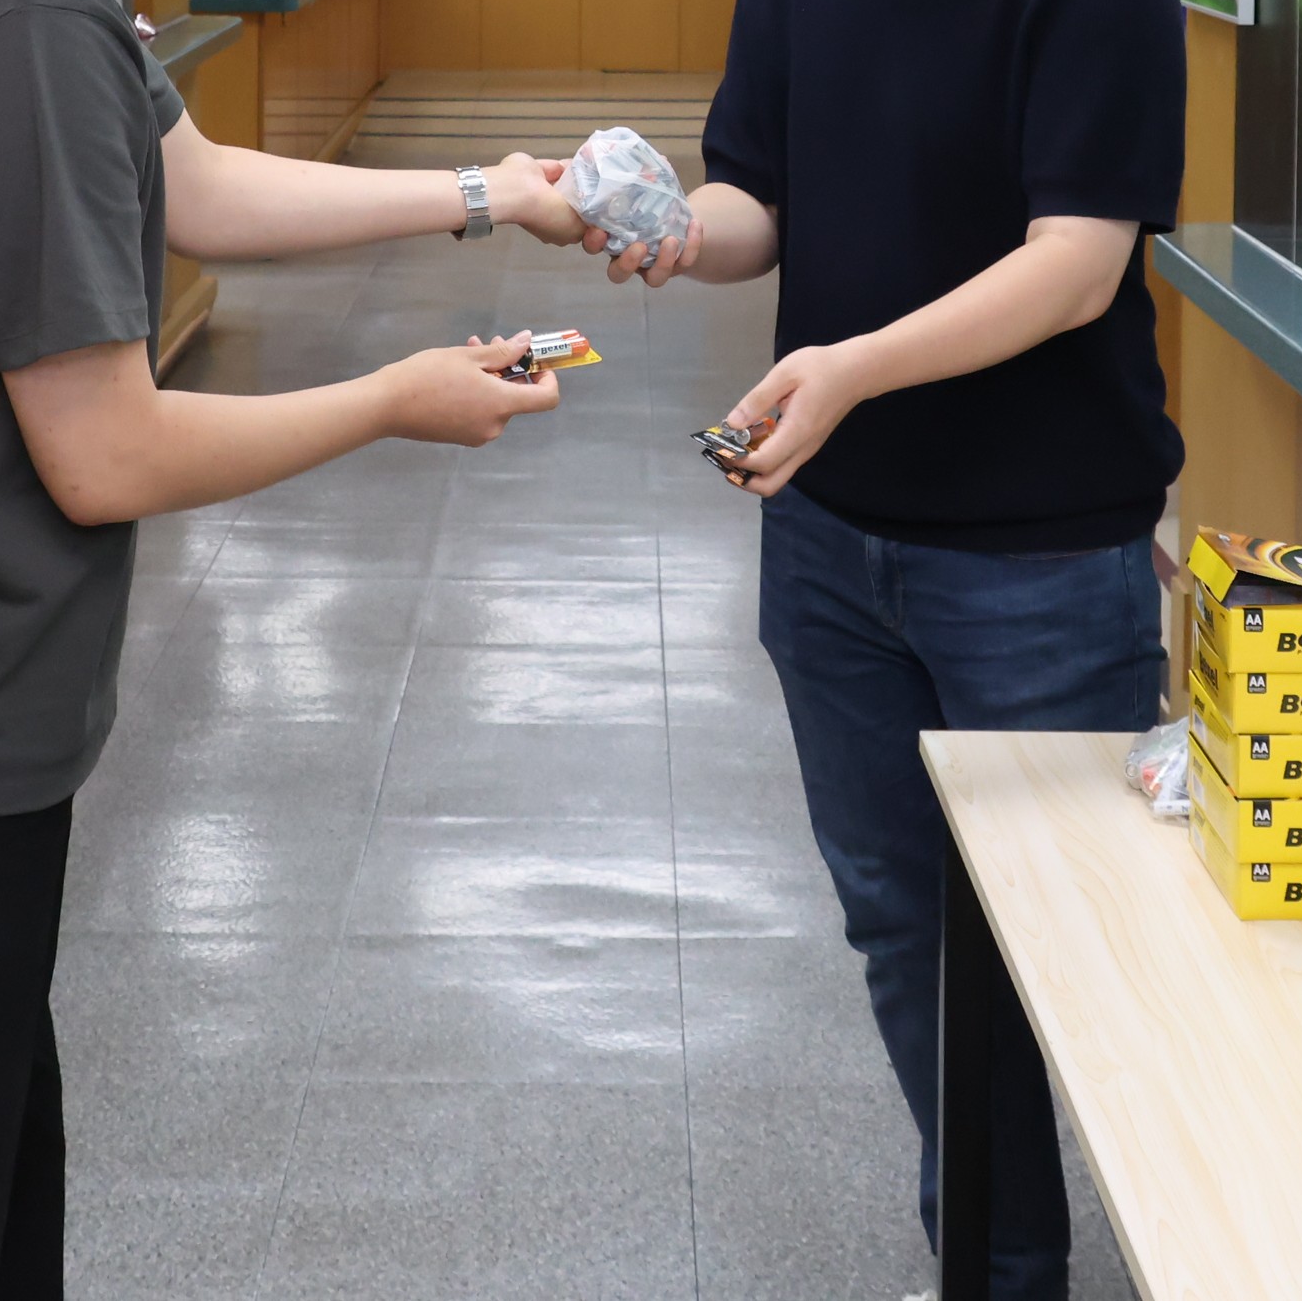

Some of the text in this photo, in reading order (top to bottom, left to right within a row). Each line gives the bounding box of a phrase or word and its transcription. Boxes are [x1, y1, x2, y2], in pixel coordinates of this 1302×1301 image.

[1245, 613, 1262, 626] AA
[1249, 675, 1266, 688] AA
[1252, 741, 1269, 754] AA
[1254, 809, 1271, 821] AA
[1253, 864, 1270, 876] AA
